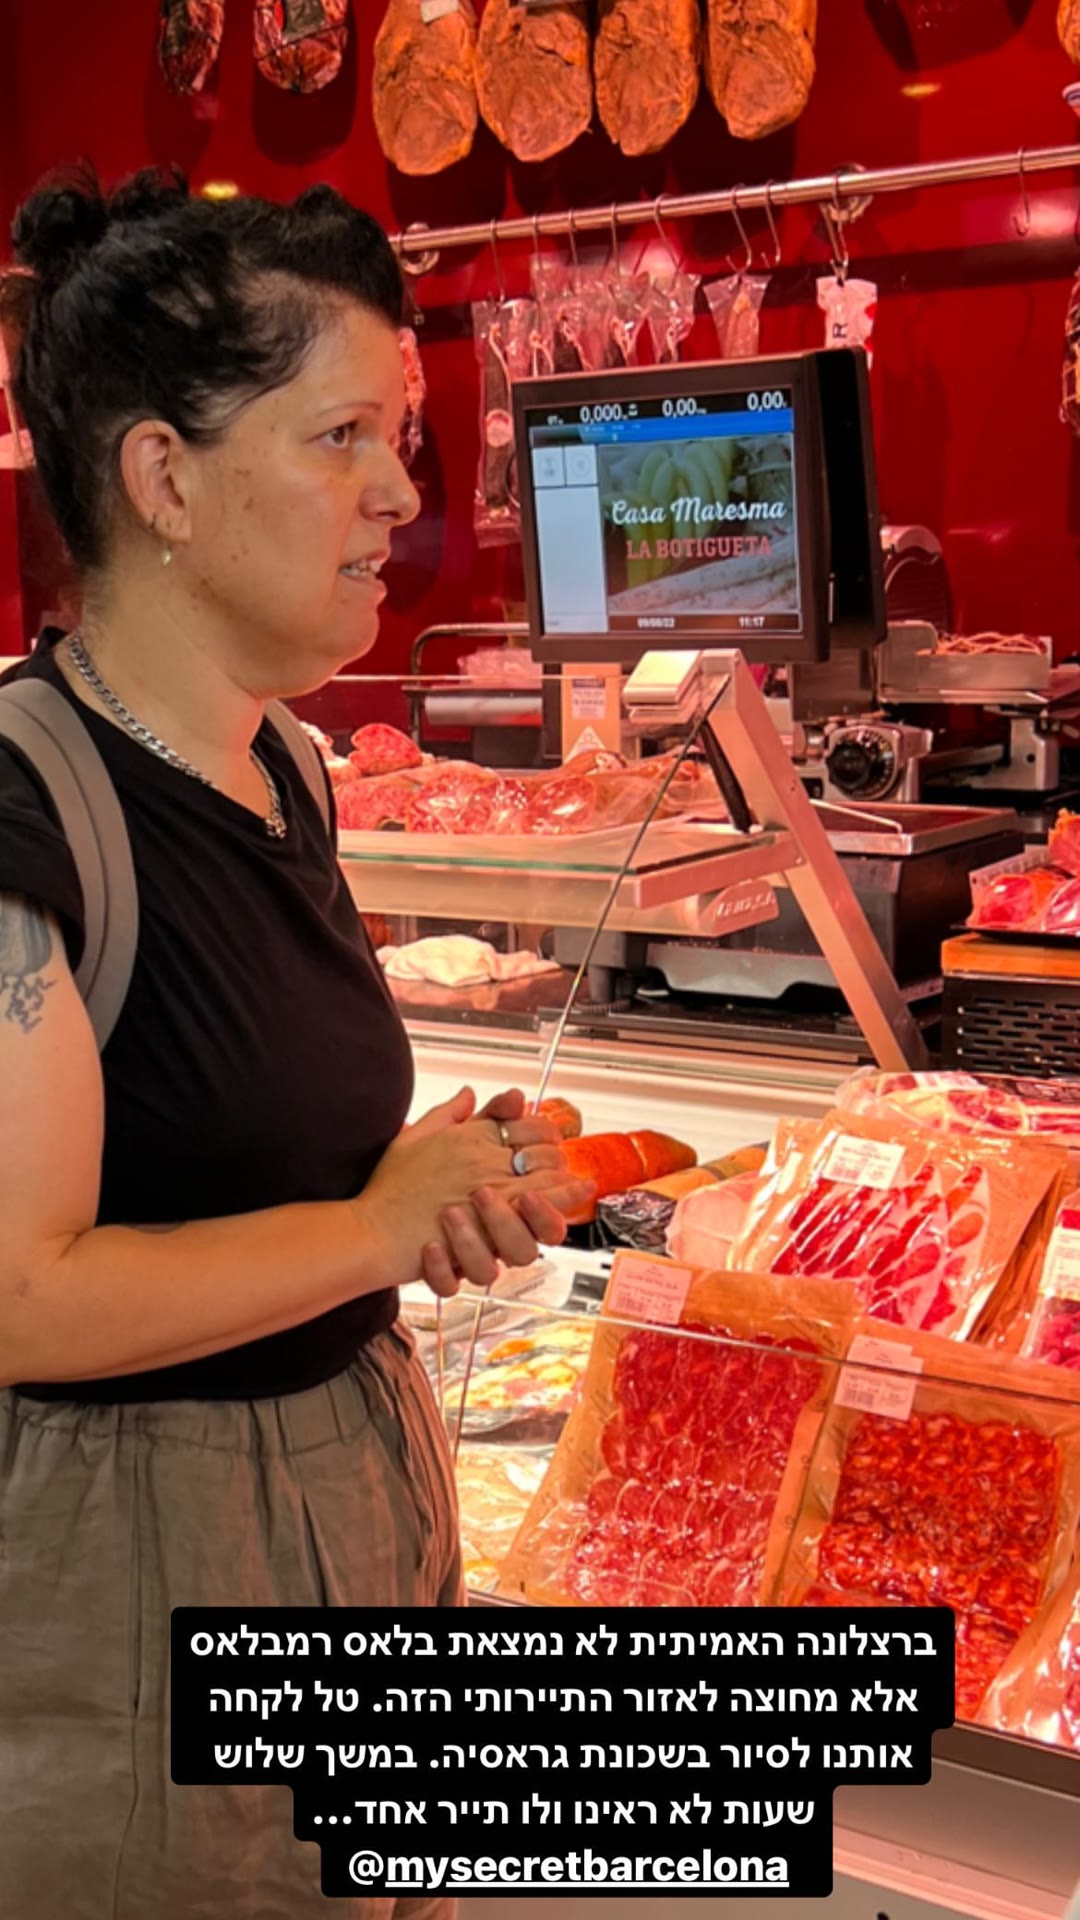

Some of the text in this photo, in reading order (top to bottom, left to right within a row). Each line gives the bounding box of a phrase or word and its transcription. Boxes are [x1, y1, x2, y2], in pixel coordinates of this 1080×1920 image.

[612, 496, 787, 524] Casa Maresma
[626, 536, 773, 560] LA BOTIGUETA
